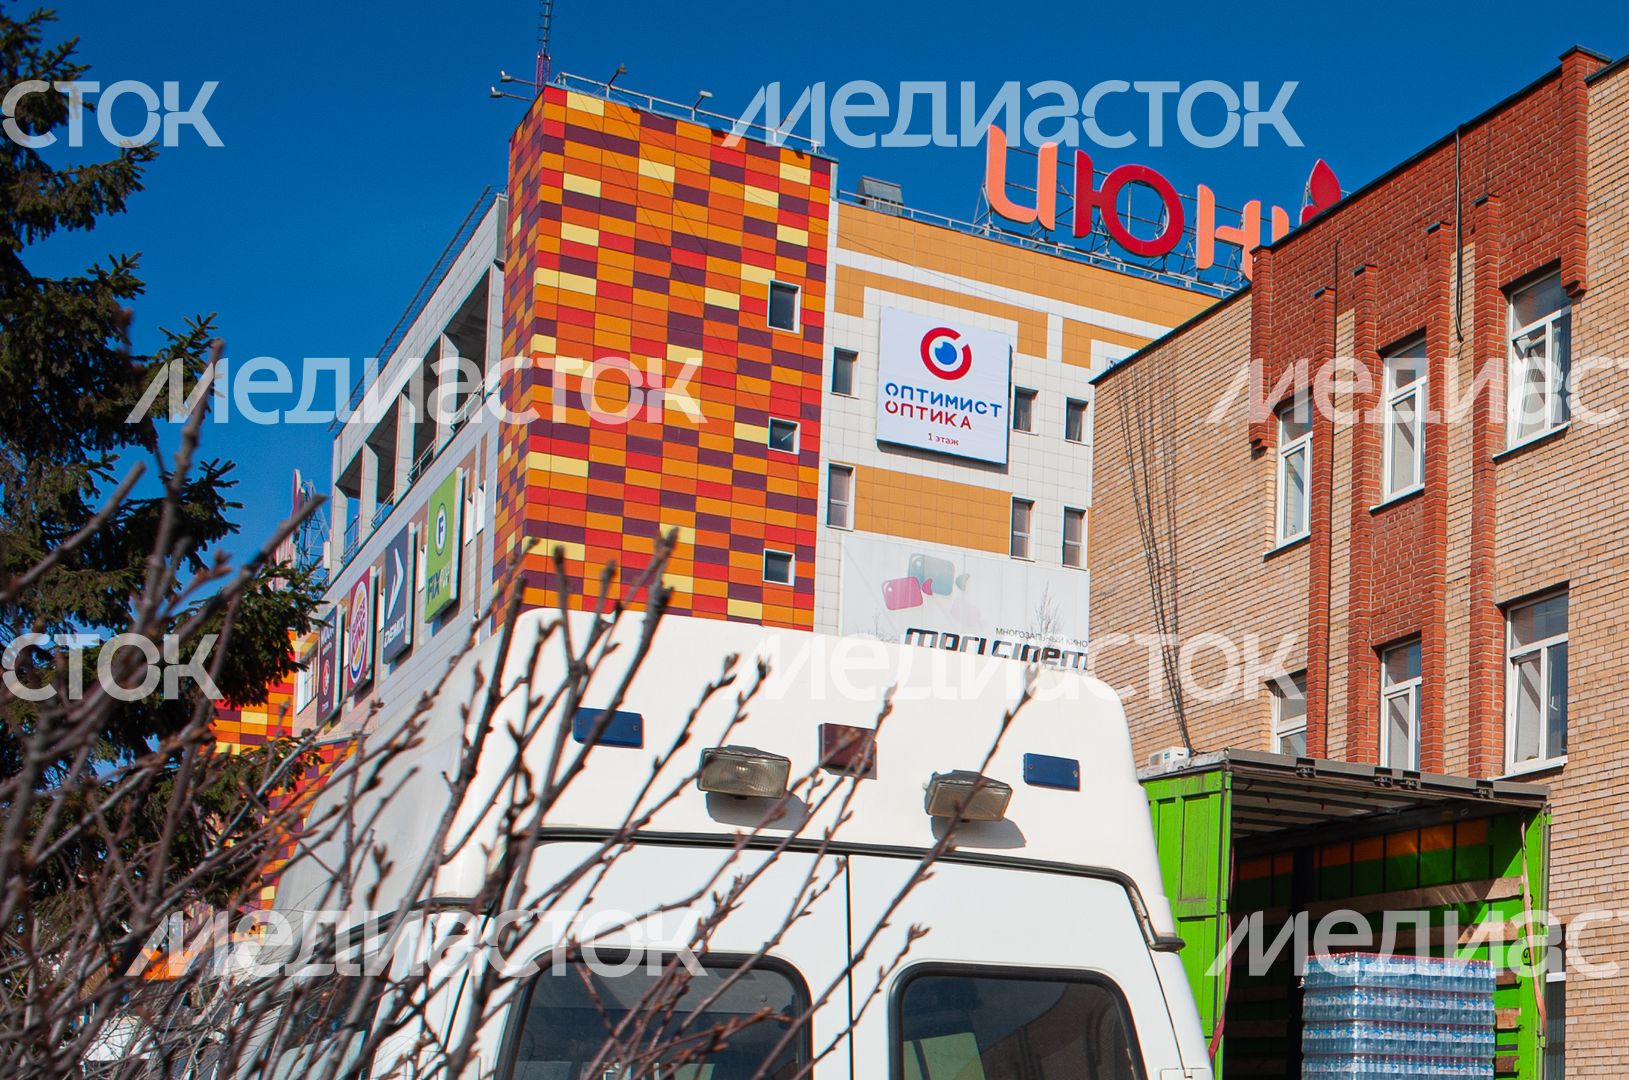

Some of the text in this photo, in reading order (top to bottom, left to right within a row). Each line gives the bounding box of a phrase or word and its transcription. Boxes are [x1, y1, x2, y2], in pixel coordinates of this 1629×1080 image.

[885, 382, 1002, 418] ОПТИМИСТ
[885, 400, 972, 430] ОПТИКА
[928, 432, 959, 446] 1 этаж
